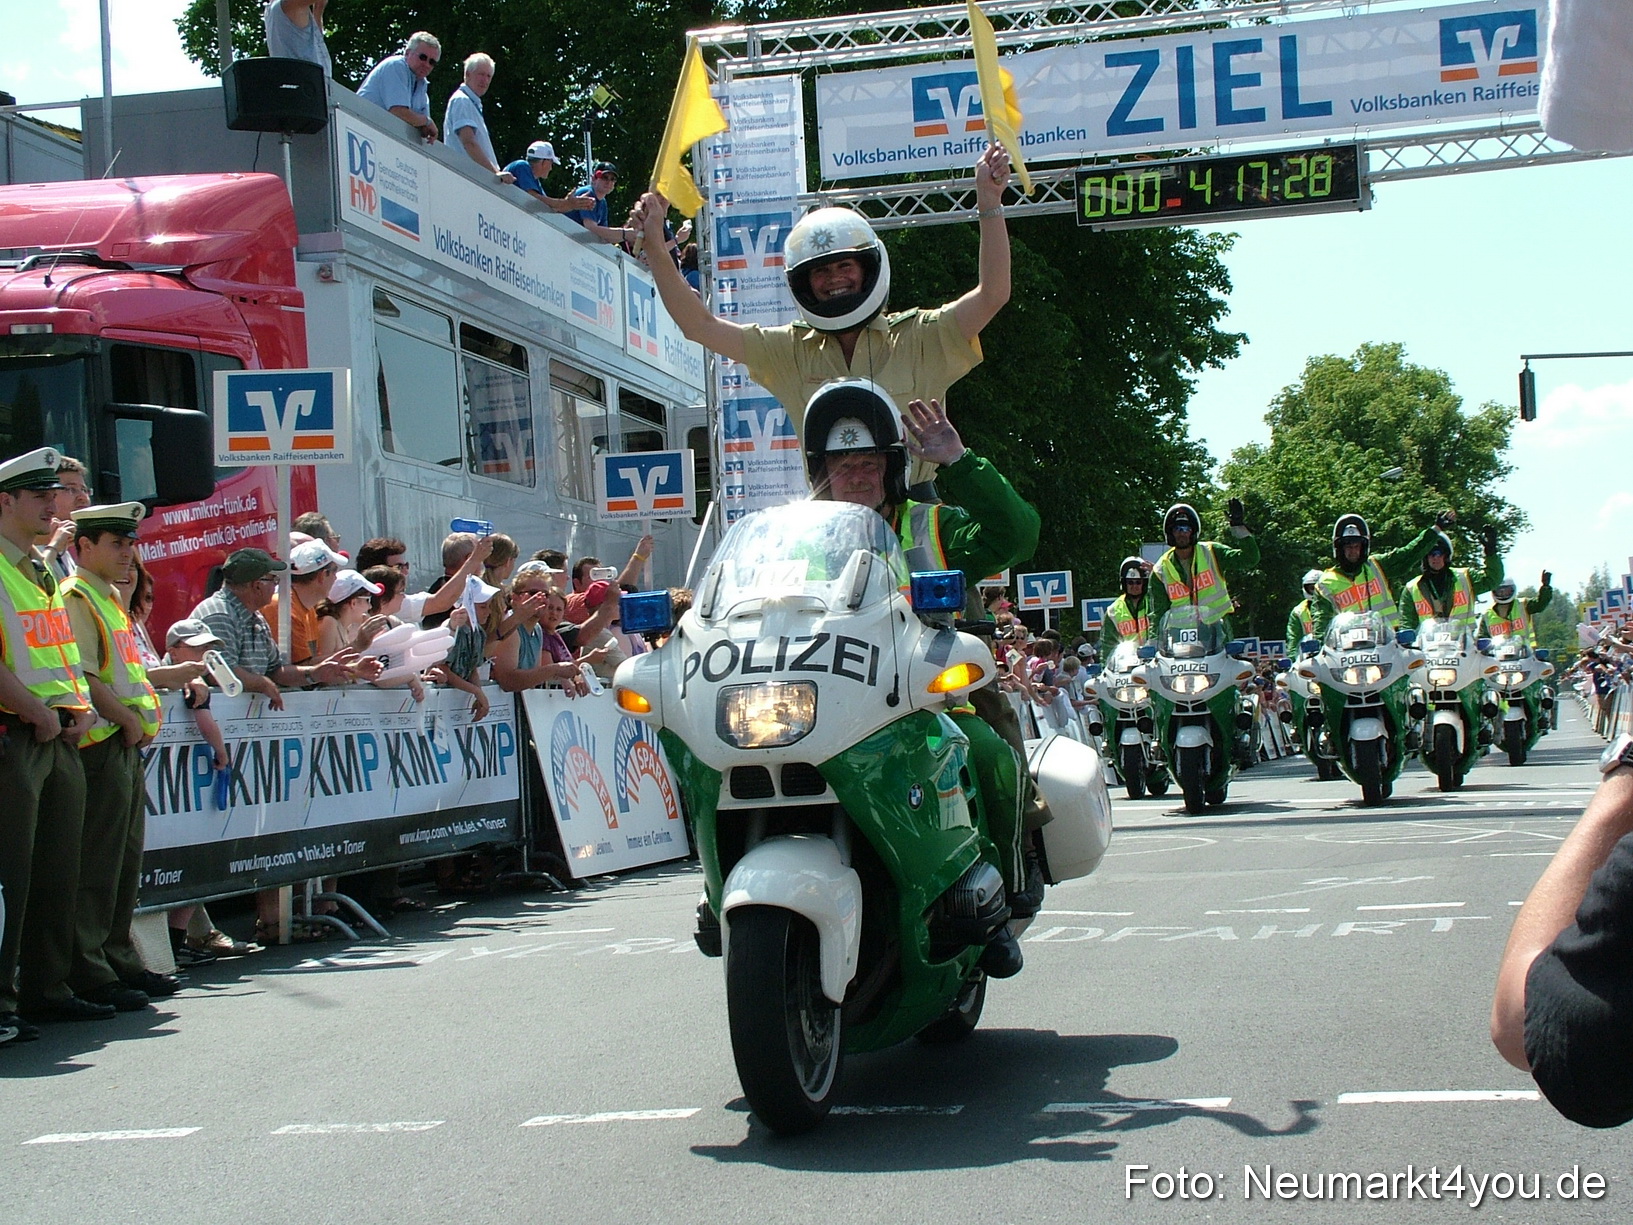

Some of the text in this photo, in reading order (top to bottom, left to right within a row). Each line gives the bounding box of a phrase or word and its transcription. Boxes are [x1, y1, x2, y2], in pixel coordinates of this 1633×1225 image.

[1104, 34, 1332, 138] ZIEL
[1350, 89, 1466, 114] Volksbanken
[347, 131, 376, 184] DG
[833, 126, 1087, 168] Volksbanken Raiffenbanken
[735, 164, 776, 173] Volksbanken
[736, 171, 791, 180] Raiffeisenbanken
[349, 175, 377, 216] HYP
[478, 213, 527, 258] Partner der
[433, 225, 493, 276] Volksbanken
[495, 256, 566, 310] Raiffeisenbanken
[597, 266, 614, 305] DG
[740, 276, 781, 284] Volksbanken
[742, 300, 782, 308] Volksbanken
[742, 305, 796, 316] Raiffeisenbanken
[218, 451, 345, 462] Volksbanken Raiffeisenbanken
[747, 459, 788, 467] Volksbanken
[748, 465, 803, 474] Raiffeisenbanken
[162, 493, 258, 526] www.mikro-funk.de
[600, 509, 692, 520] Volksbanken Raiffeisenbanken
[137, 515, 277, 562] Mail: mikro-funk@t-online.de
[1181, 630, 1197, 643] 03
[680, 632, 881, 700] POLIZEI
[1170, 663, 1209, 674] POLIZEI
[1341, 653, 1380, 667] POLIZEI
[309, 732, 380, 799] KMP
[384, 729, 453, 789] KMP
[454, 722, 515, 781] KMP
[551, 717, 573, 807] GEWINN
[615, 717, 640, 800] GEWINN
[225, 737, 304, 808] KMP
[571, 751, 615, 826] SPAREN
[637, 746, 675, 817] SPAREN
[399, 817, 507, 845] www.kmp.com InkJet Toner
[229, 839, 366, 874] www.kmp.com InkJet Toner
[153, 868, 184, 887] Toner
